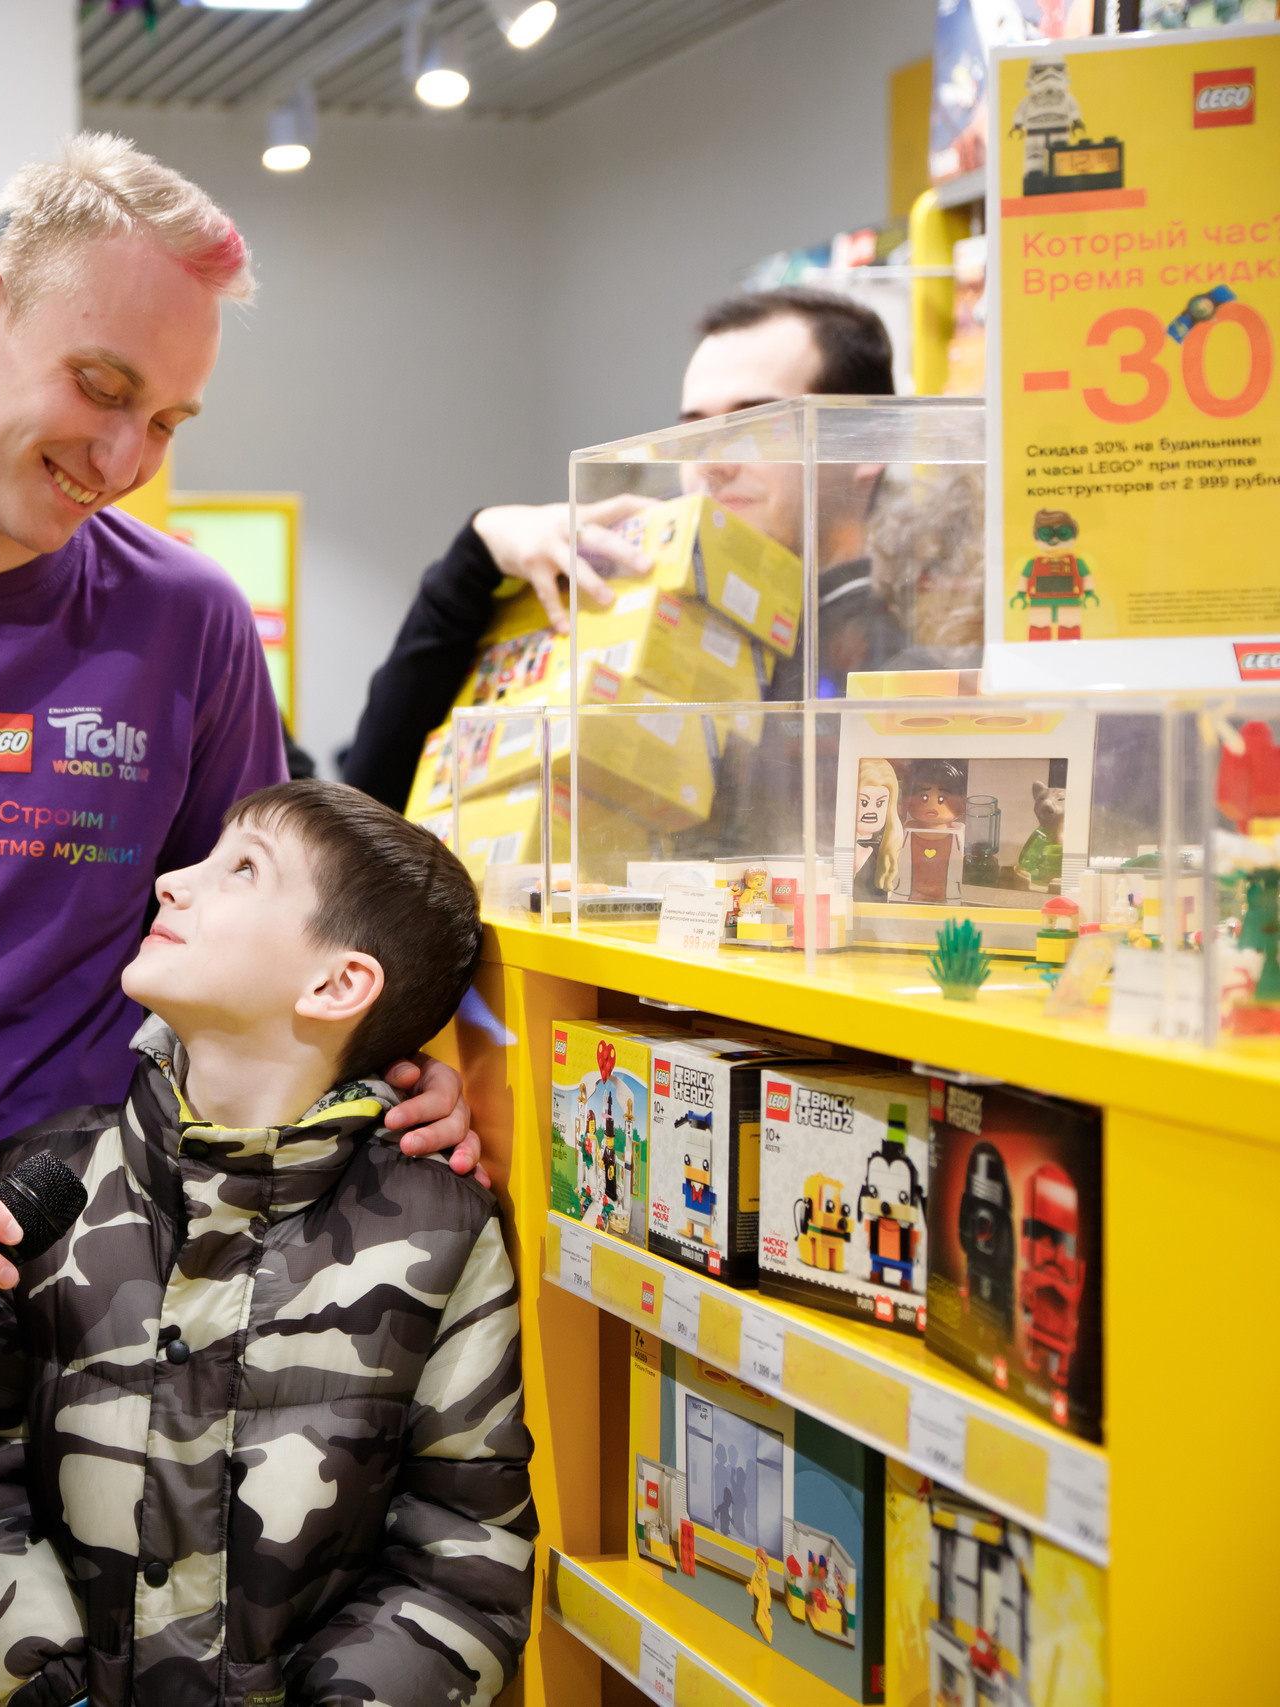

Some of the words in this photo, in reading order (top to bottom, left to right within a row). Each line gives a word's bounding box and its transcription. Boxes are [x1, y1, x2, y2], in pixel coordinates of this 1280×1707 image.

[1196, 84, 1253, 112] LEGO
[1023, 220, 1187, 261] Который
[1023, 266, 1144, 301] Время
[1159, 258, 1280, 287] скидк
[1026, 444, 1088, 458] Скидка
[1094, 440, 1128, 454] 30%
[1134, 442, 1154, 453] на
[1160, 436, 1262, 454] будильники
[1026, 467, 1037, 476] и
[1042, 464, 1083, 476] часы
[1149, 461, 1180, 474] при
[1186, 457, 1257, 471] покупке
[1026, 482, 1154, 499] конструкторов
[1160, 481, 1176, 490] от
[1183, 477, 1194, 490] 2
[47, 712, 148, 764] Trolls
[52, 760, 114, 778] WORLD
[118, 764, 150, 783] TOUR
[775, 886, 791, 895] LEGO
[683, 935, 700, 949] 899
[555, 1039, 567, 1055] LEGO
[655, 1069, 670, 1086] LEGO
[684, 1067, 714, 1091] BRICK
[673, 1080, 714, 1109] HEADZ
[767, 1093, 789, 1111] LEGO
[811, 1090, 855, 1115] BRICK
[653, 1100, 665, 1114] 10+
[795, 1105, 854, 1134] HEADZ
[765, 1127, 781, 1142] 10+
[652, 1202, 670, 1214] MICKEY
[652, 1212, 670, 1223] MOUSE
[762, 1236, 789, 1249] MICKEY
[762, 1246, 788, 1258] MOUSE
[643, 1290, 654, 1305] LEGO
[634, 1329, 645, 1347] 7+
